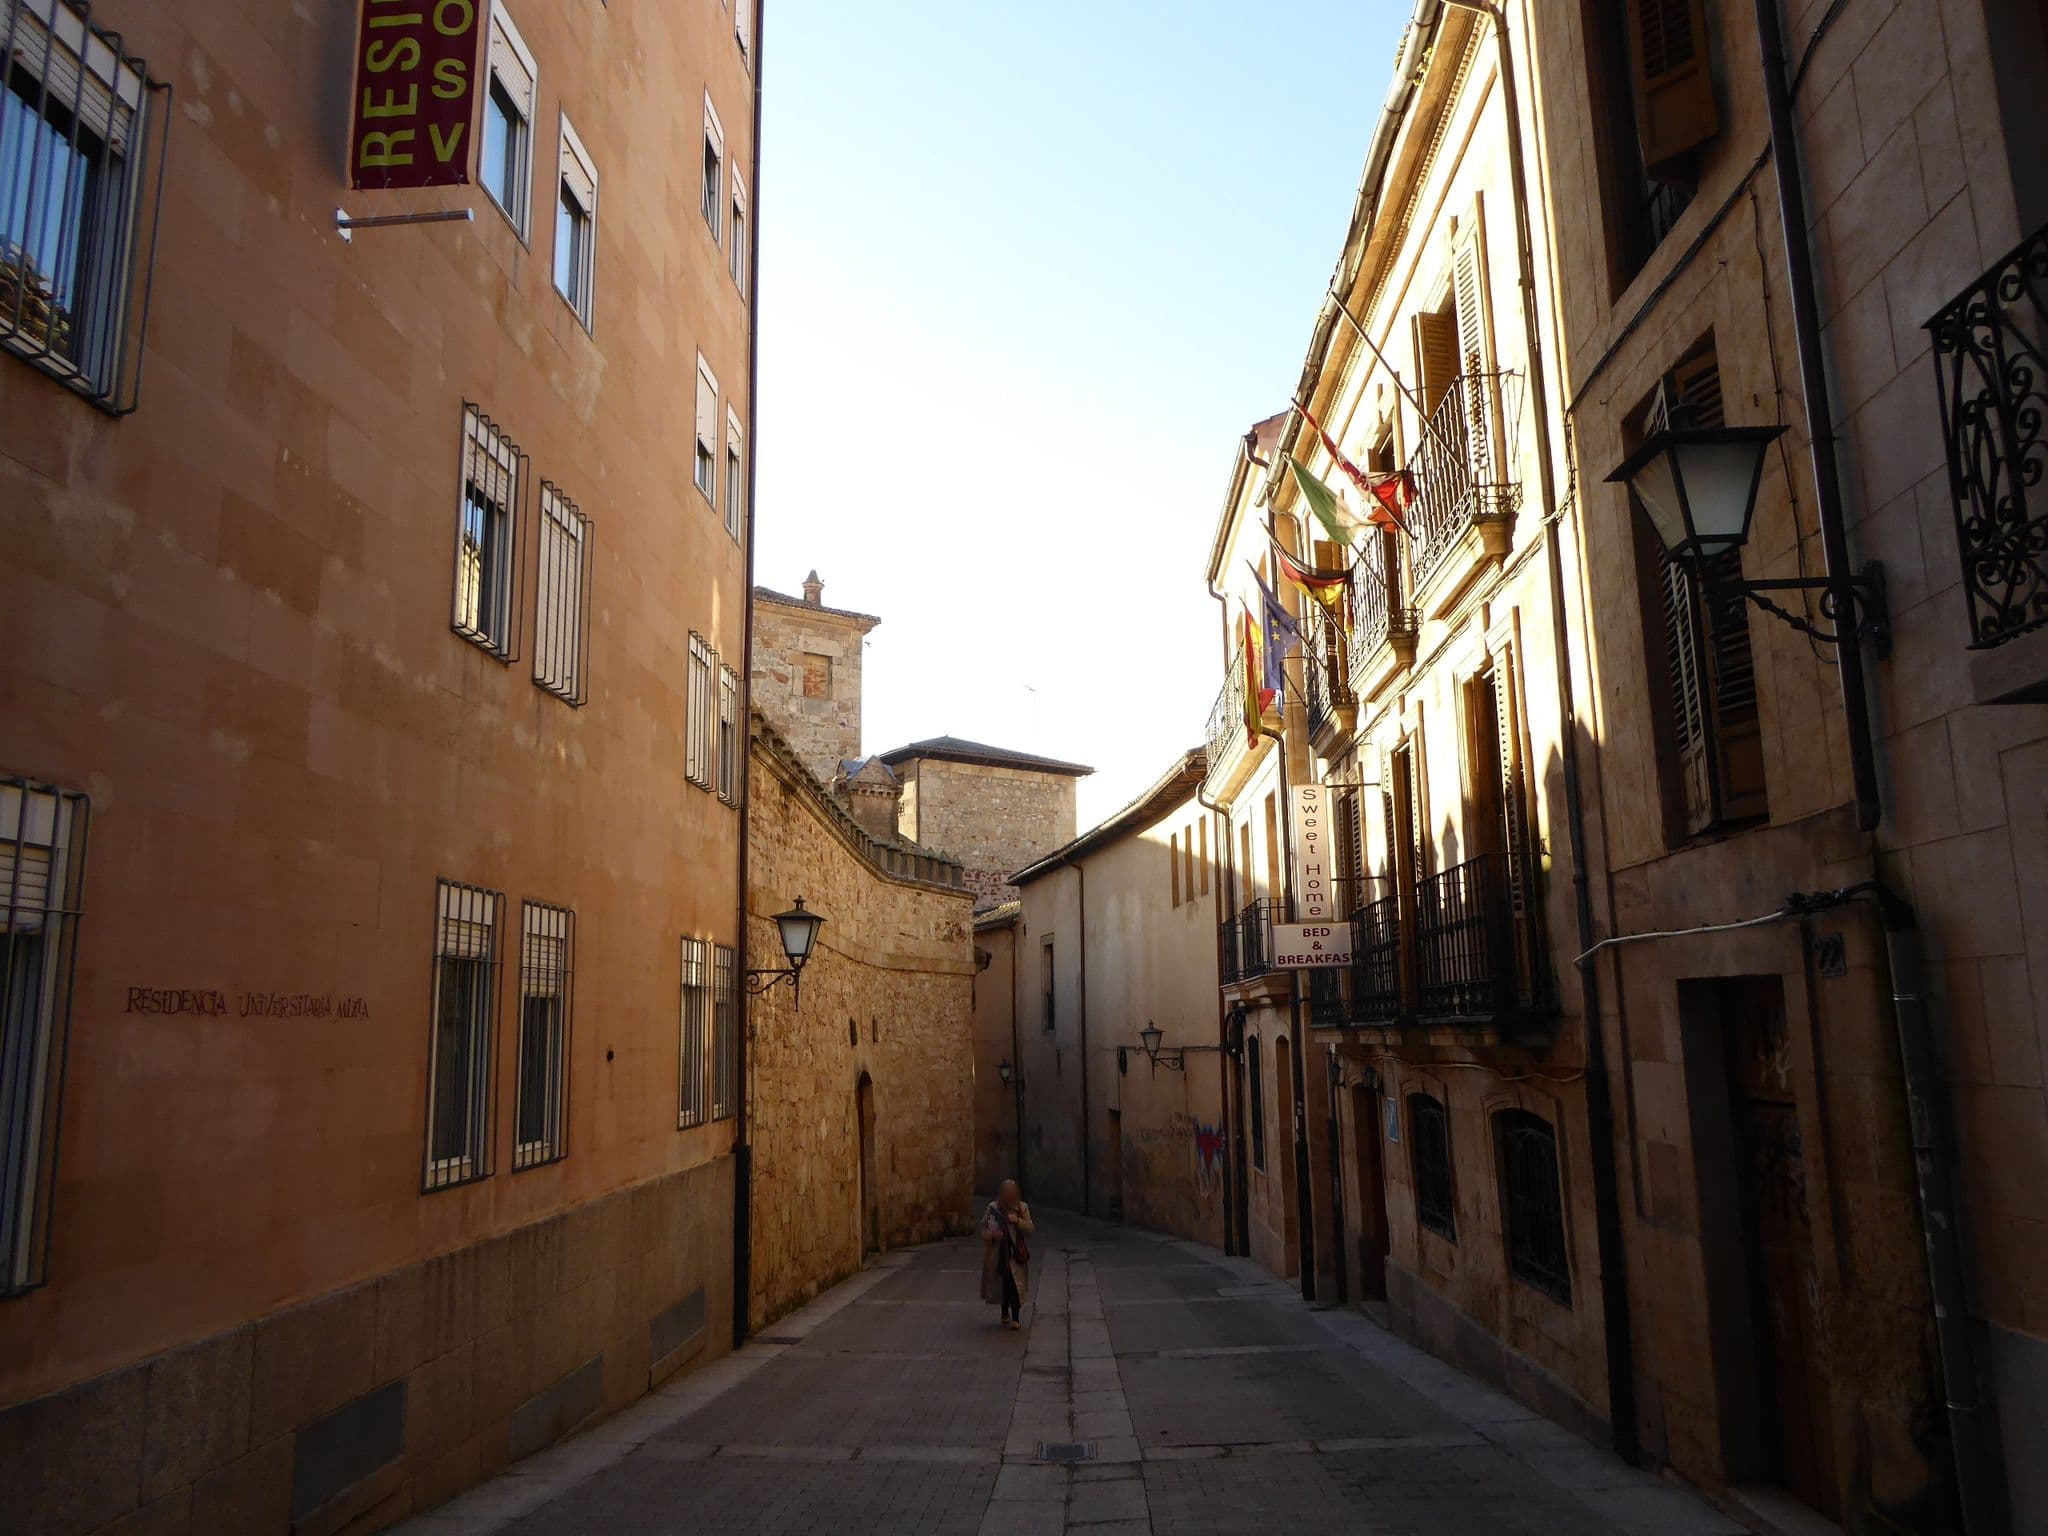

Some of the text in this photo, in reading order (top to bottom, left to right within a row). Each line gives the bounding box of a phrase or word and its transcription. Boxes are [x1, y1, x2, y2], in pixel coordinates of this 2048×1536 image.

[360, 0, 423, 168] RESI
[1302, 789, 1323, 916] Sweet Home
[1302, 928, 1331, 937] BED
[1312, 941, 1323, 950] &
[1277, 953, 1352, 965] BREAKFAS
